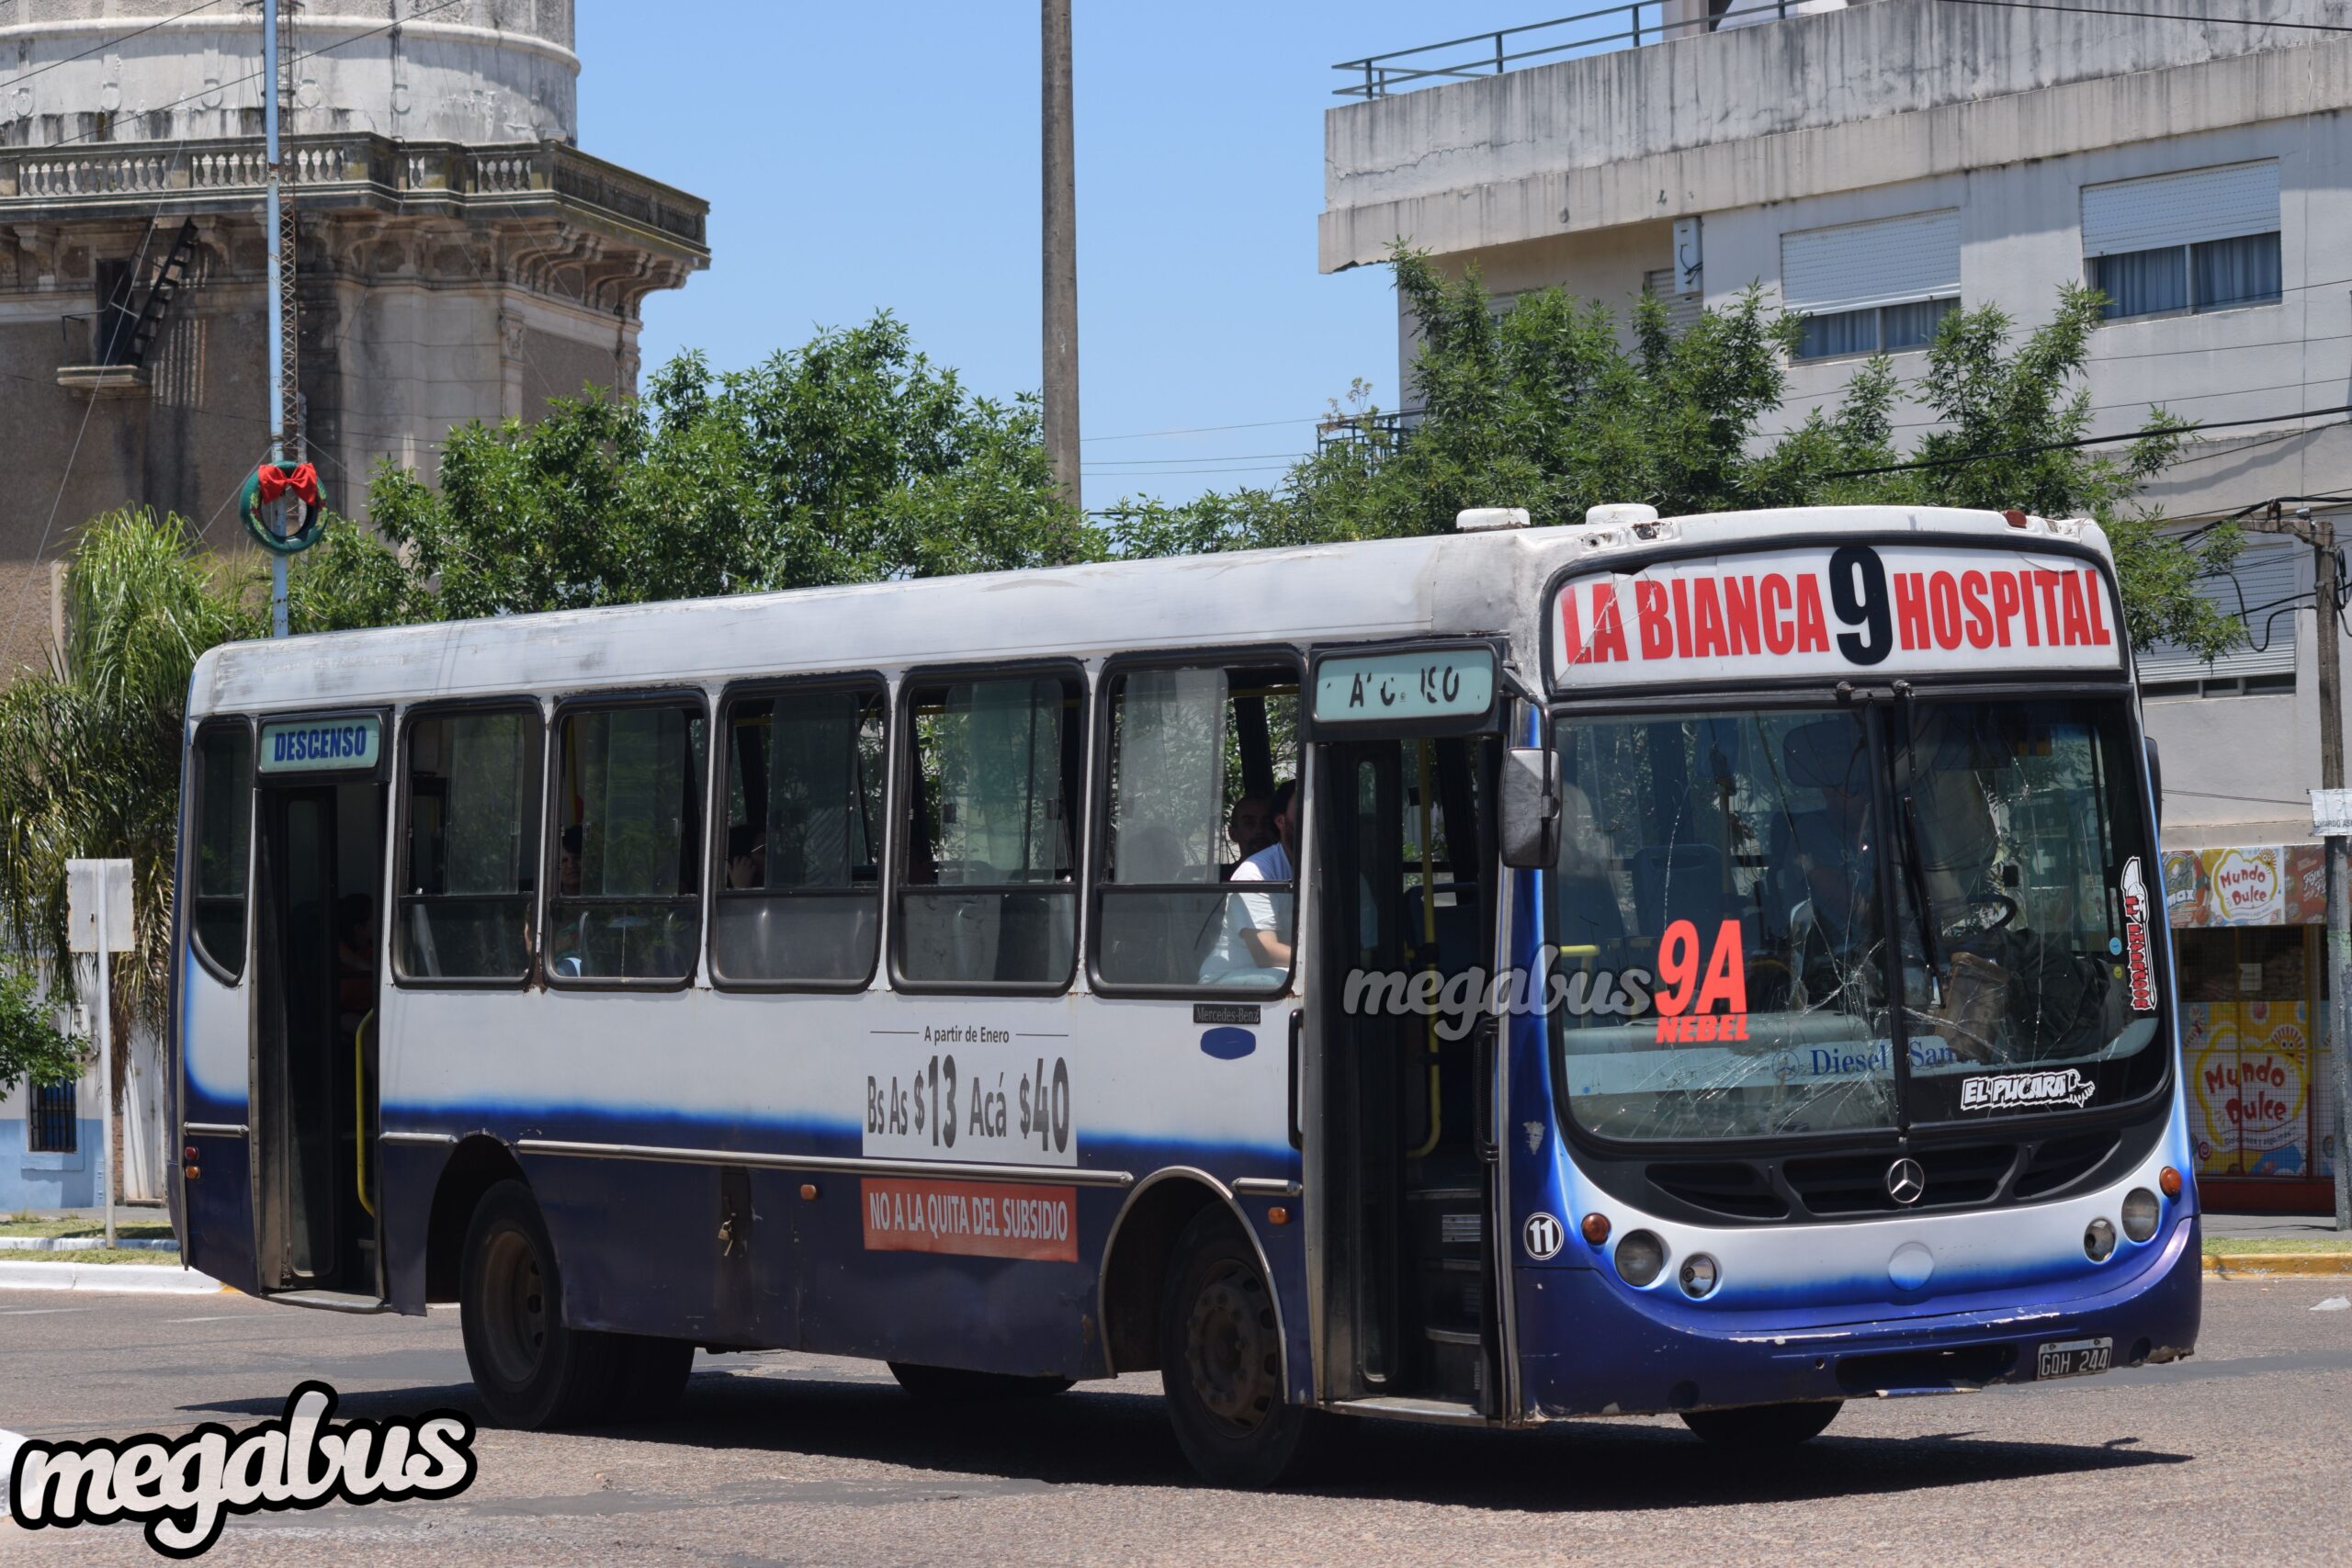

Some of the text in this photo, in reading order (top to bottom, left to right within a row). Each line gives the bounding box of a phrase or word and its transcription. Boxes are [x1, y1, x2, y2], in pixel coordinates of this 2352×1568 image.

[1560, 545, 2111, 666] LA BIANCA 9 HOSPITAL
[274, 725, 368, 762] DESCENSO
[2220, 864, 2266, 889] Mundo
[2232, 886, 2267, 906] Dulce
[1654, 919, 1747, 1017] 9A
[1196, 1006, 1261, 1022] Mercedes-Benz
[1656, 1014, 1750, 1043] NEBEL
[924, 1024, 1010, 1046] A partir de Enero
[1810, 1043, 1888, 1076] Diesel
[2204, 1055, 2286, 1095] Mundo
[867, 1075, 885, 1135] Bs
[888, 1076, 908, 1136] As
[968, 1071, 1007, 1138] Acá
[1963, 1073, 2068, 1105] EL PUCARA
[2225, 1089, 2287, 1125] Dulce
[869, 1192, 1069, 1241] NO A LA QUITA DEL SUBSIDIO
[1529, 1219, 1555, 1253] 11
[2078, 1348, 2109, 1372] 244
